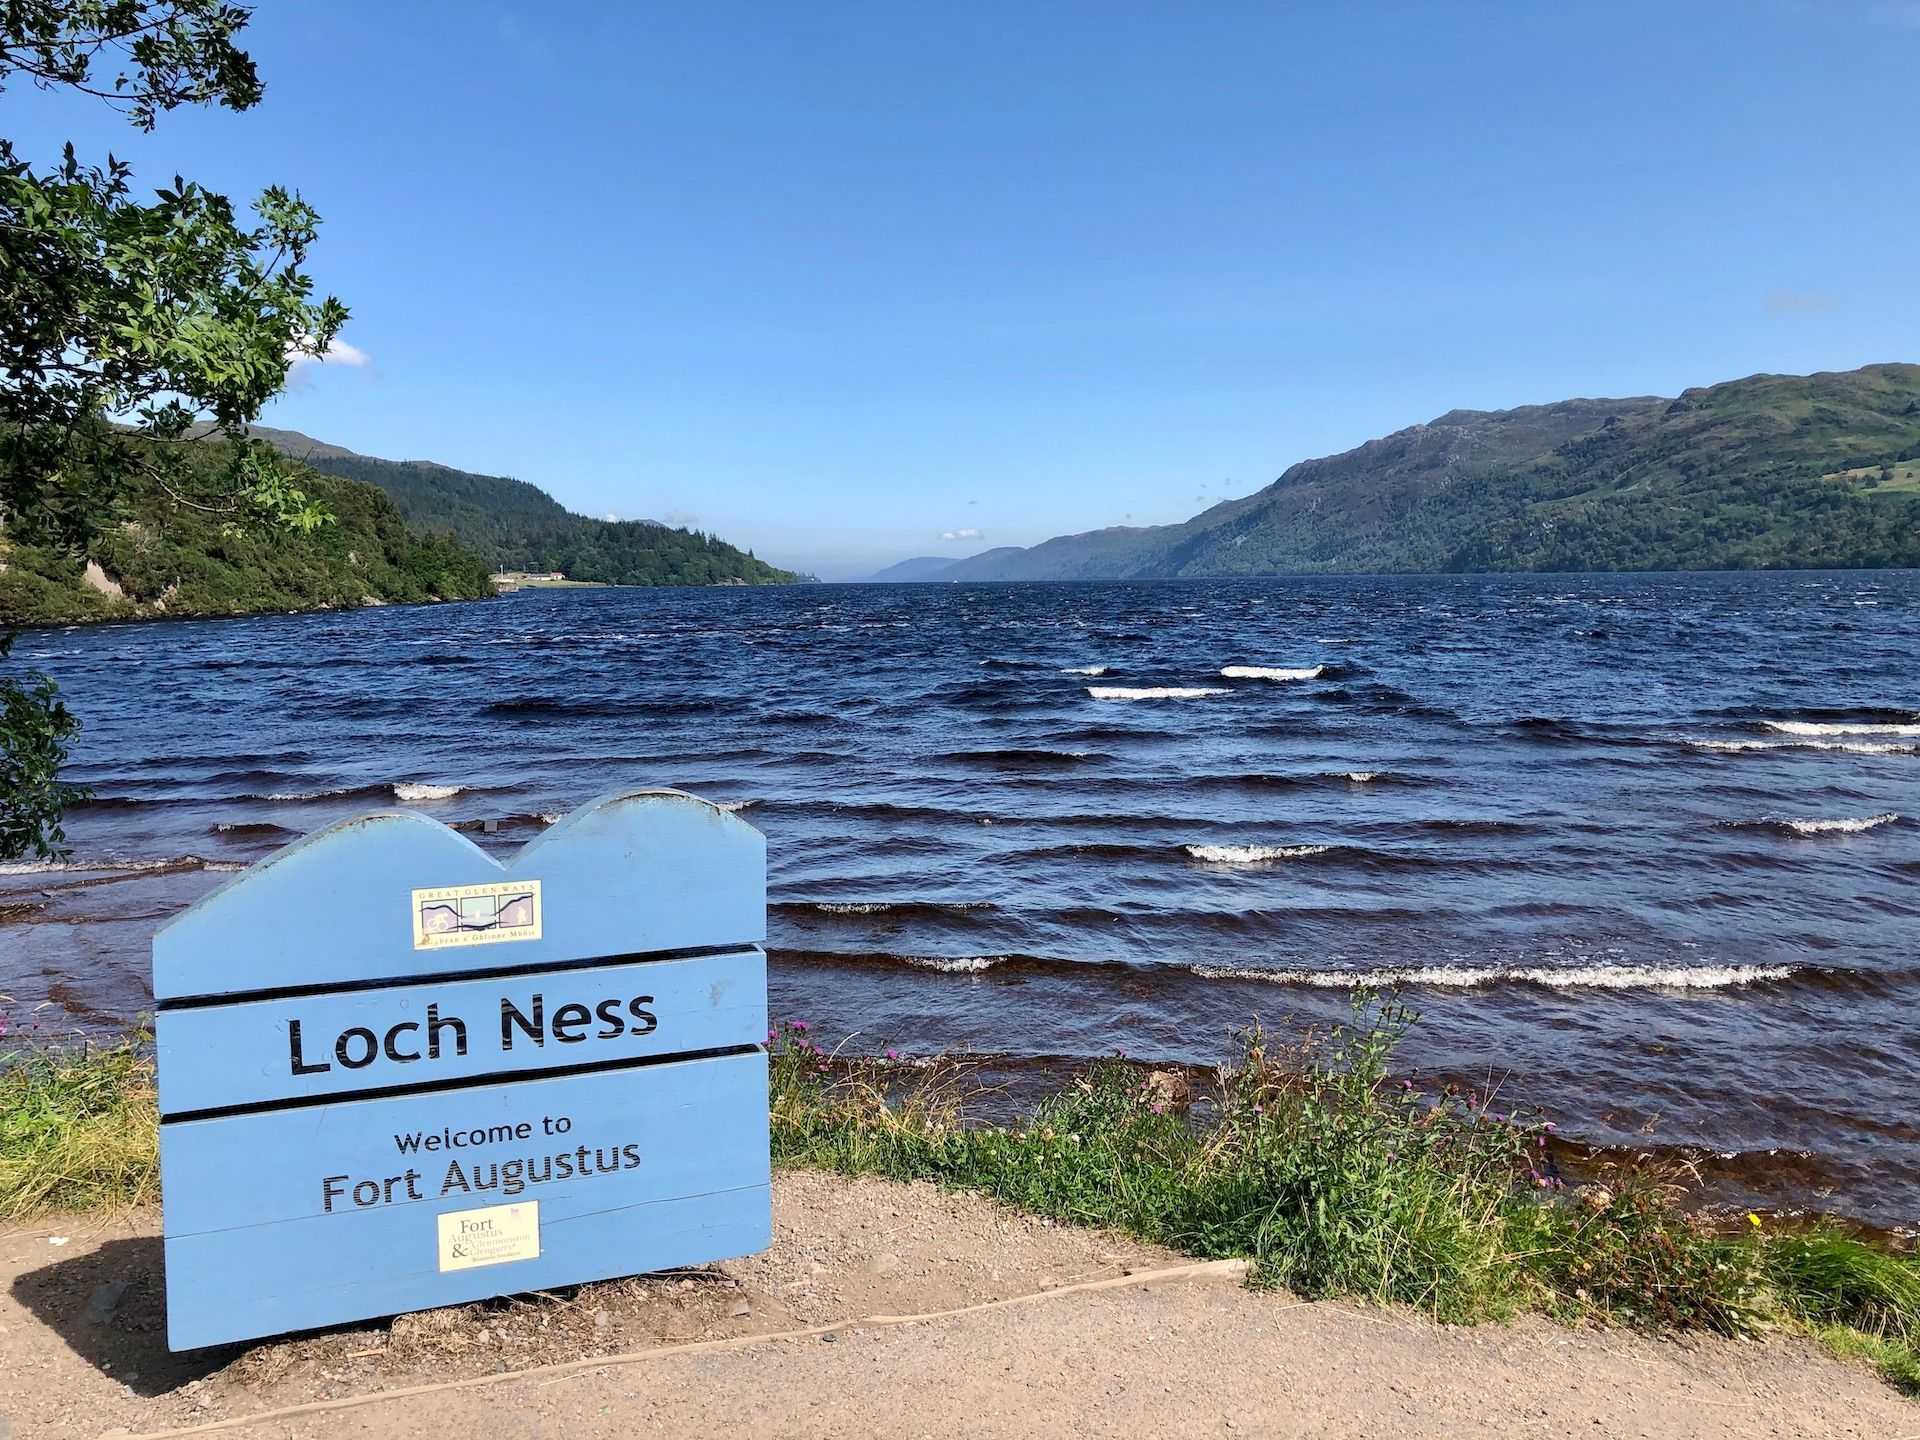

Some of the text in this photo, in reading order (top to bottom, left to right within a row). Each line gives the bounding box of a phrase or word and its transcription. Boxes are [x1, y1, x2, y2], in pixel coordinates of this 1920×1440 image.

[419, 884, 535, 899] GREAT GLEN WAYS
[289, 993, 659, 1076] Loch Ness
[393, 1115, 572, 1156] Welcome to
[322, 1142, 642, 1213] Fort Augustus
[460, 1219, 493, 1234] Fort
[449, 1229, 503, 1245] Augustus
[452, 1243, 468, 1259] &
